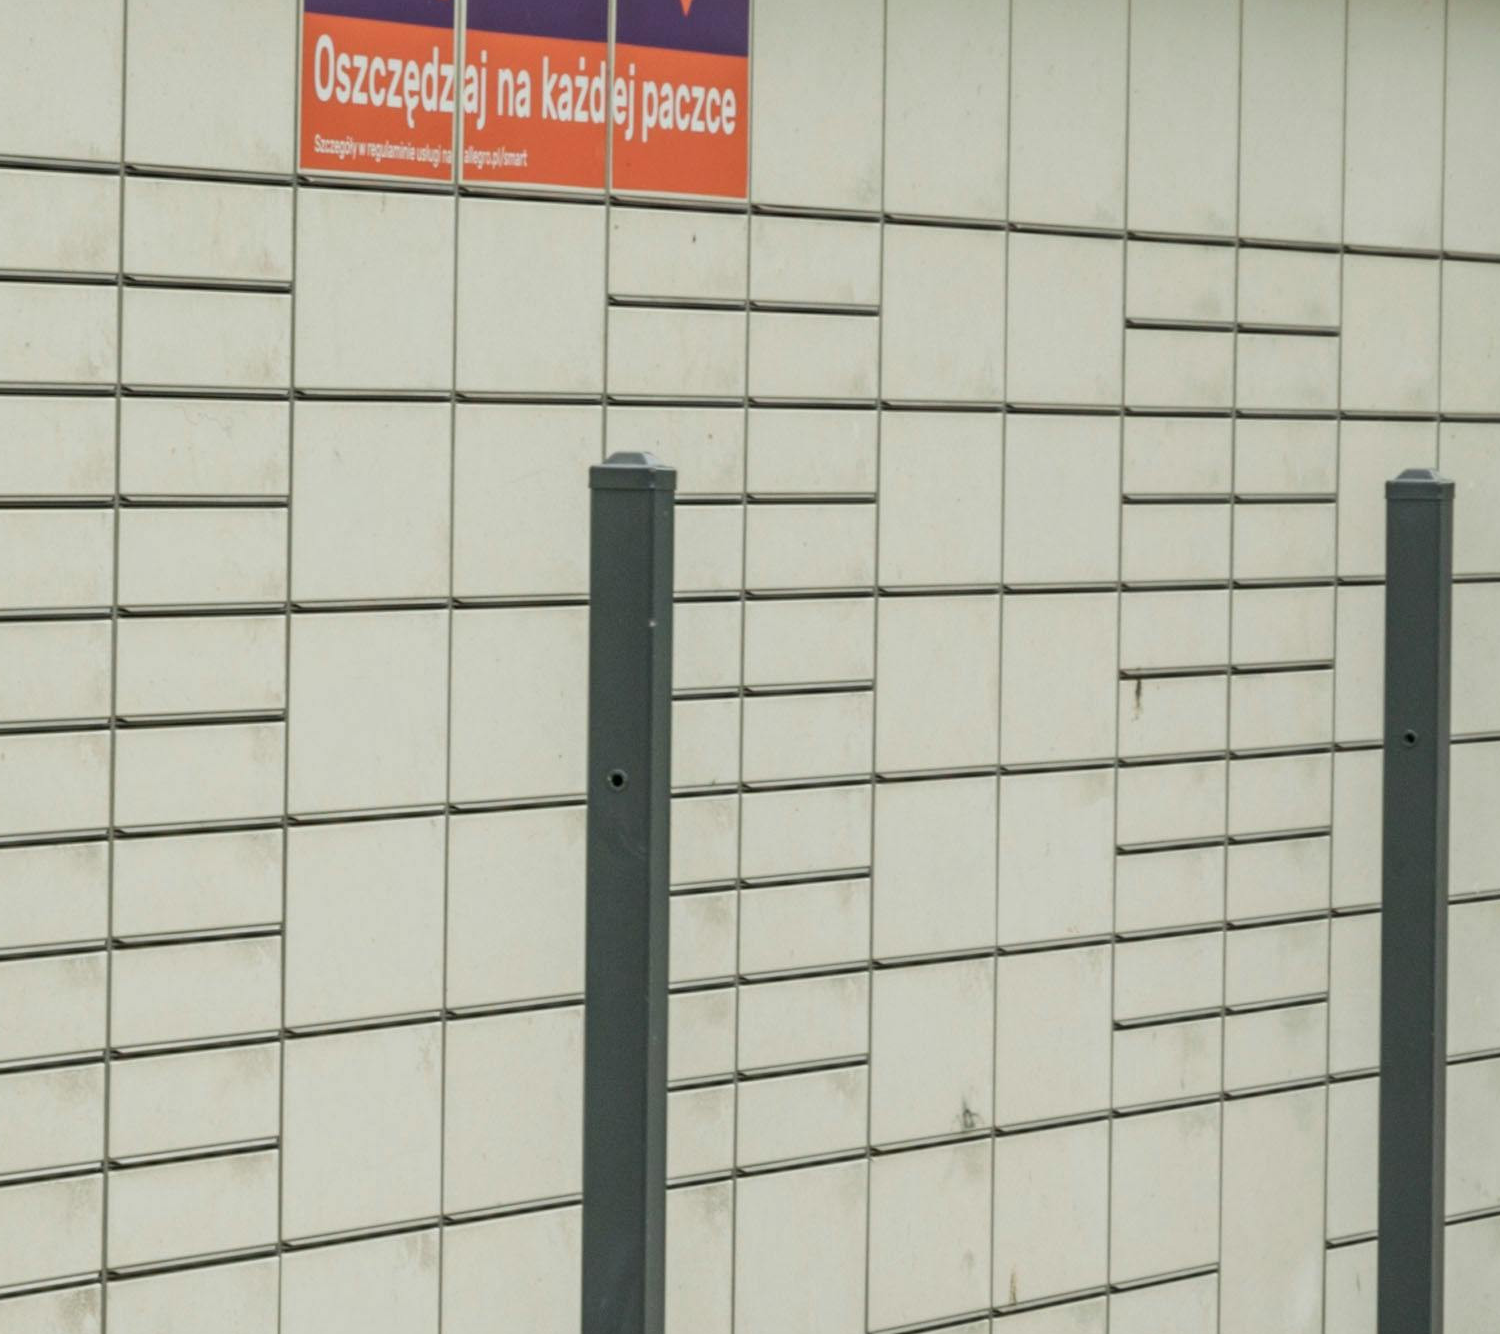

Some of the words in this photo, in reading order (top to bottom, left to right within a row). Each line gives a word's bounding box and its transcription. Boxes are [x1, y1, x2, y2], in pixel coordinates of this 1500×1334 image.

[314, 33, 489, 130] Oszczędzaj
[498, 67, 532, 120] na
[542, 55, 636, 142] każdej
[641, 78, 737, 144] paczce
